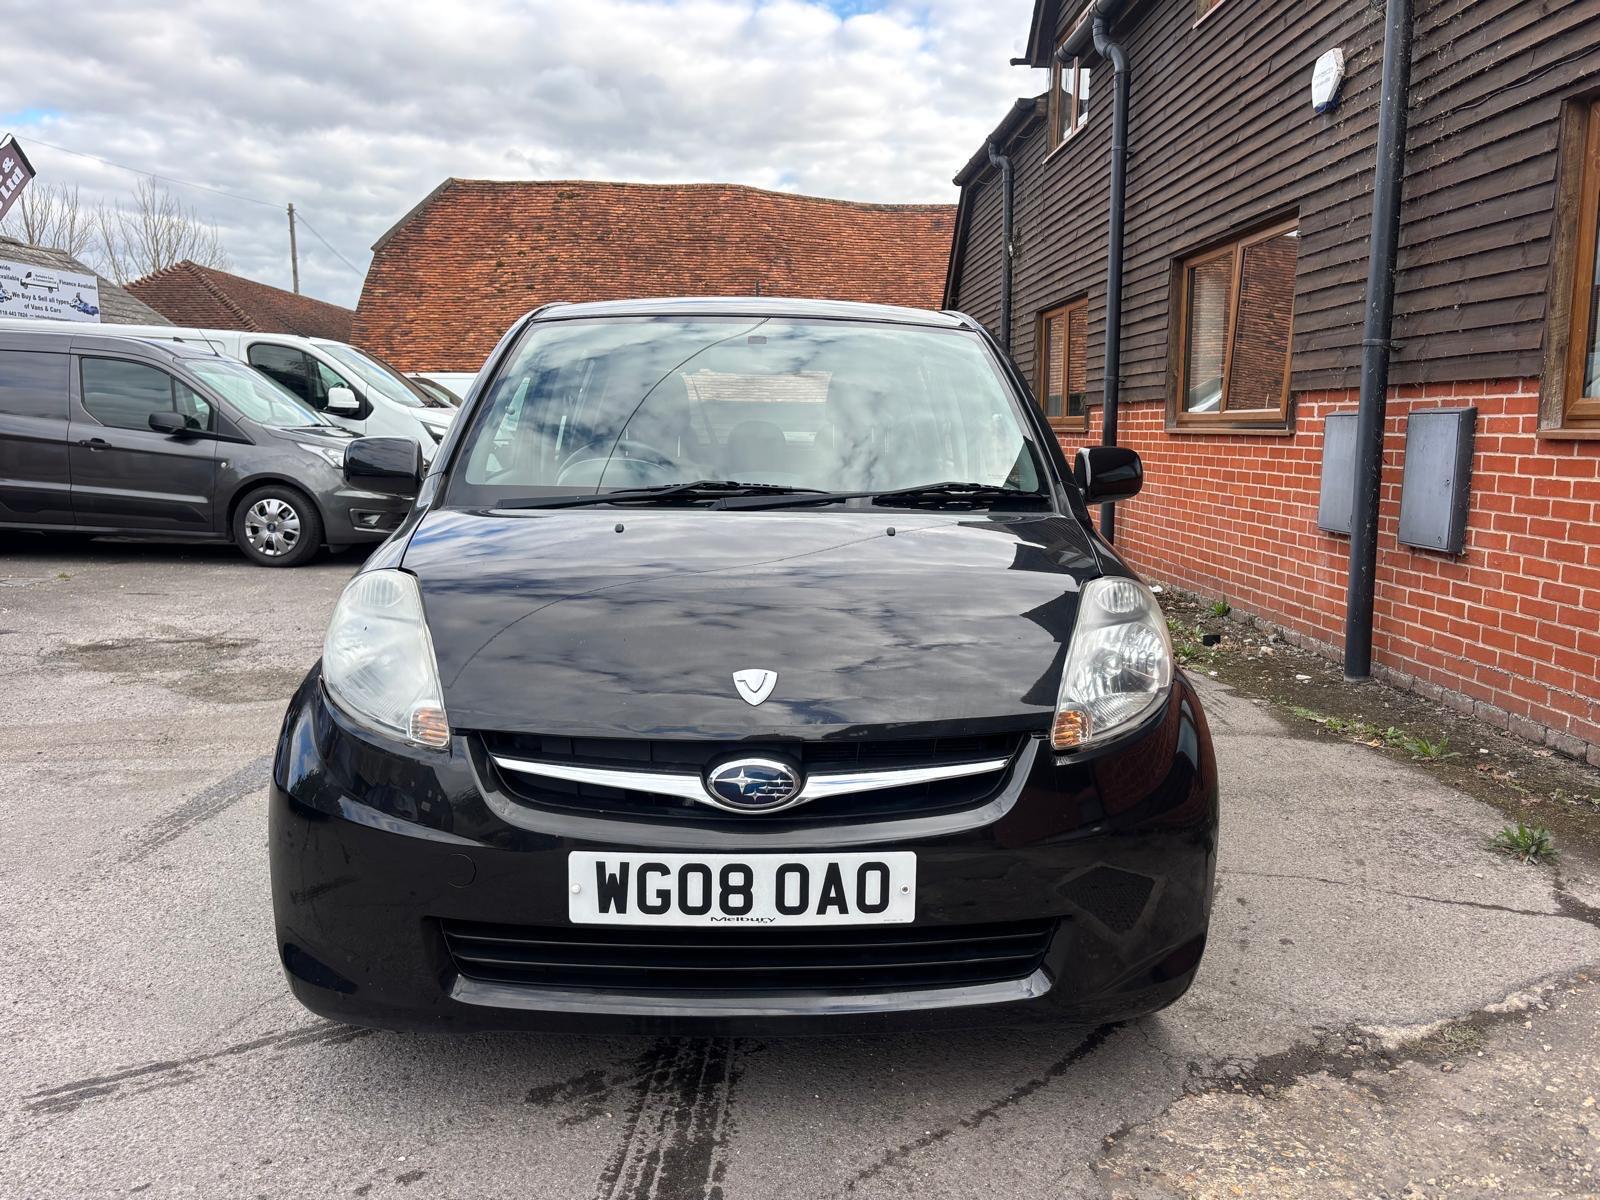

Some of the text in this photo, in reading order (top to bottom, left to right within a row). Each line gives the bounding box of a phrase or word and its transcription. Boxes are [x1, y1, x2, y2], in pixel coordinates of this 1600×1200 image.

[2, 156, 14, 174] &
[0, 166, 25, 200] Ltd
[59, 279, 76, 287] Finance
[77, 282, 97, 290] Available
[12, 291, 20, 299] We
[21, 293, 31, 301] Buy
[56, 298, 69, 306] types
[595, 860, 890, 916] WG08 OAO
[710, 915, 776, 924] Melbury
